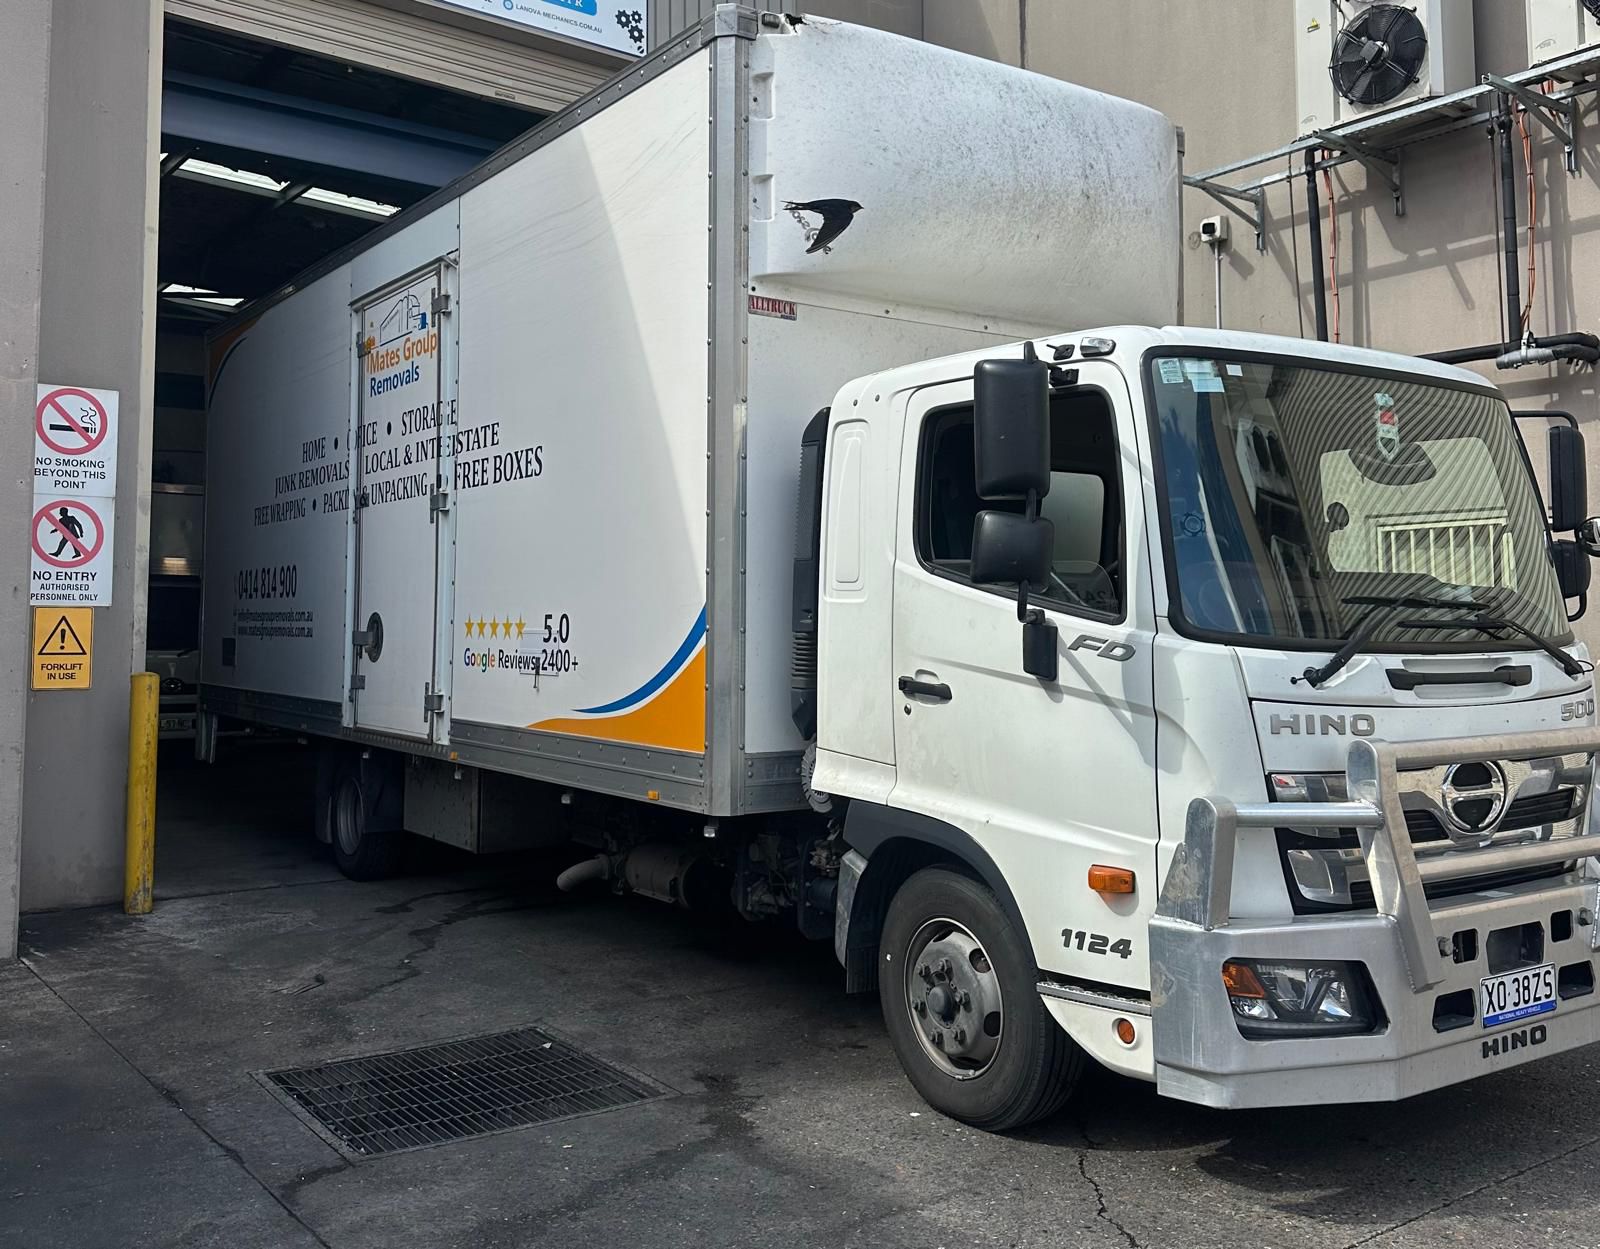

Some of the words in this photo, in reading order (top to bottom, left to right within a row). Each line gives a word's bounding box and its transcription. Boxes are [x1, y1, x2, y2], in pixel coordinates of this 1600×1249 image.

[751, 296, 796, 316] ALLTRUCK
[404, 330, 438, 361] Group
[370, 361, 420, 398] Removals
[302, 437, 326, 463] HOME
[347, 421, 378, 451] OFICE
[34, 468, 80, 478] BEYOND
[82, 470, 106, 480] THIS
[36, 457, 52, 466] NO
[55, 458, 105, 469] SMOKING
[275, 473, 297, 499] JUNK
[299, 460, 350, 489] REMOVALS
[365, 447, 401, 475] LOCAL
[403, 444, 413, 465] &
[54, 480, 86, 489] POINT
[254, 505, 269, 527] FREE
[270, 497, 306, 523] WRAPPING
[323, 488, 359, 514] PACKI
[371, 472, 428, 506] UNPACKING
[454, 458, 489, 490] FREE
[493, 445, 543, 484] BOXES
[33, 571, 52, 581] NO
[56, 571, 97, 581] ENTRY
[40, 583, 90, 591] AUTHORISED
[238, 568, 259, 600] 0414
[261, 567, 277, 599] 814
[280, 564, 297, 599] 900
[30, 593, 76, 601] PERSONNEL
[78, 593, 98, 601] ONLY
[543, 613, 570, 643] 5.0
[1067, 634, 1136, 662] FD
[41, 663, 83, 671] FORKLIFT
[464, 648, 495, 673] Google
[541, 649, 578, 672] 2400+
[47, 672, 57, 680] IN
[59, 672, 76, 680] USE
[1561, 698, 1594, 722] 500
[1270, 713, 1376, 737] HINO
[1061, 928, 1132, 959] 1124
[1482, 1024, 1547, 1059] HINO
